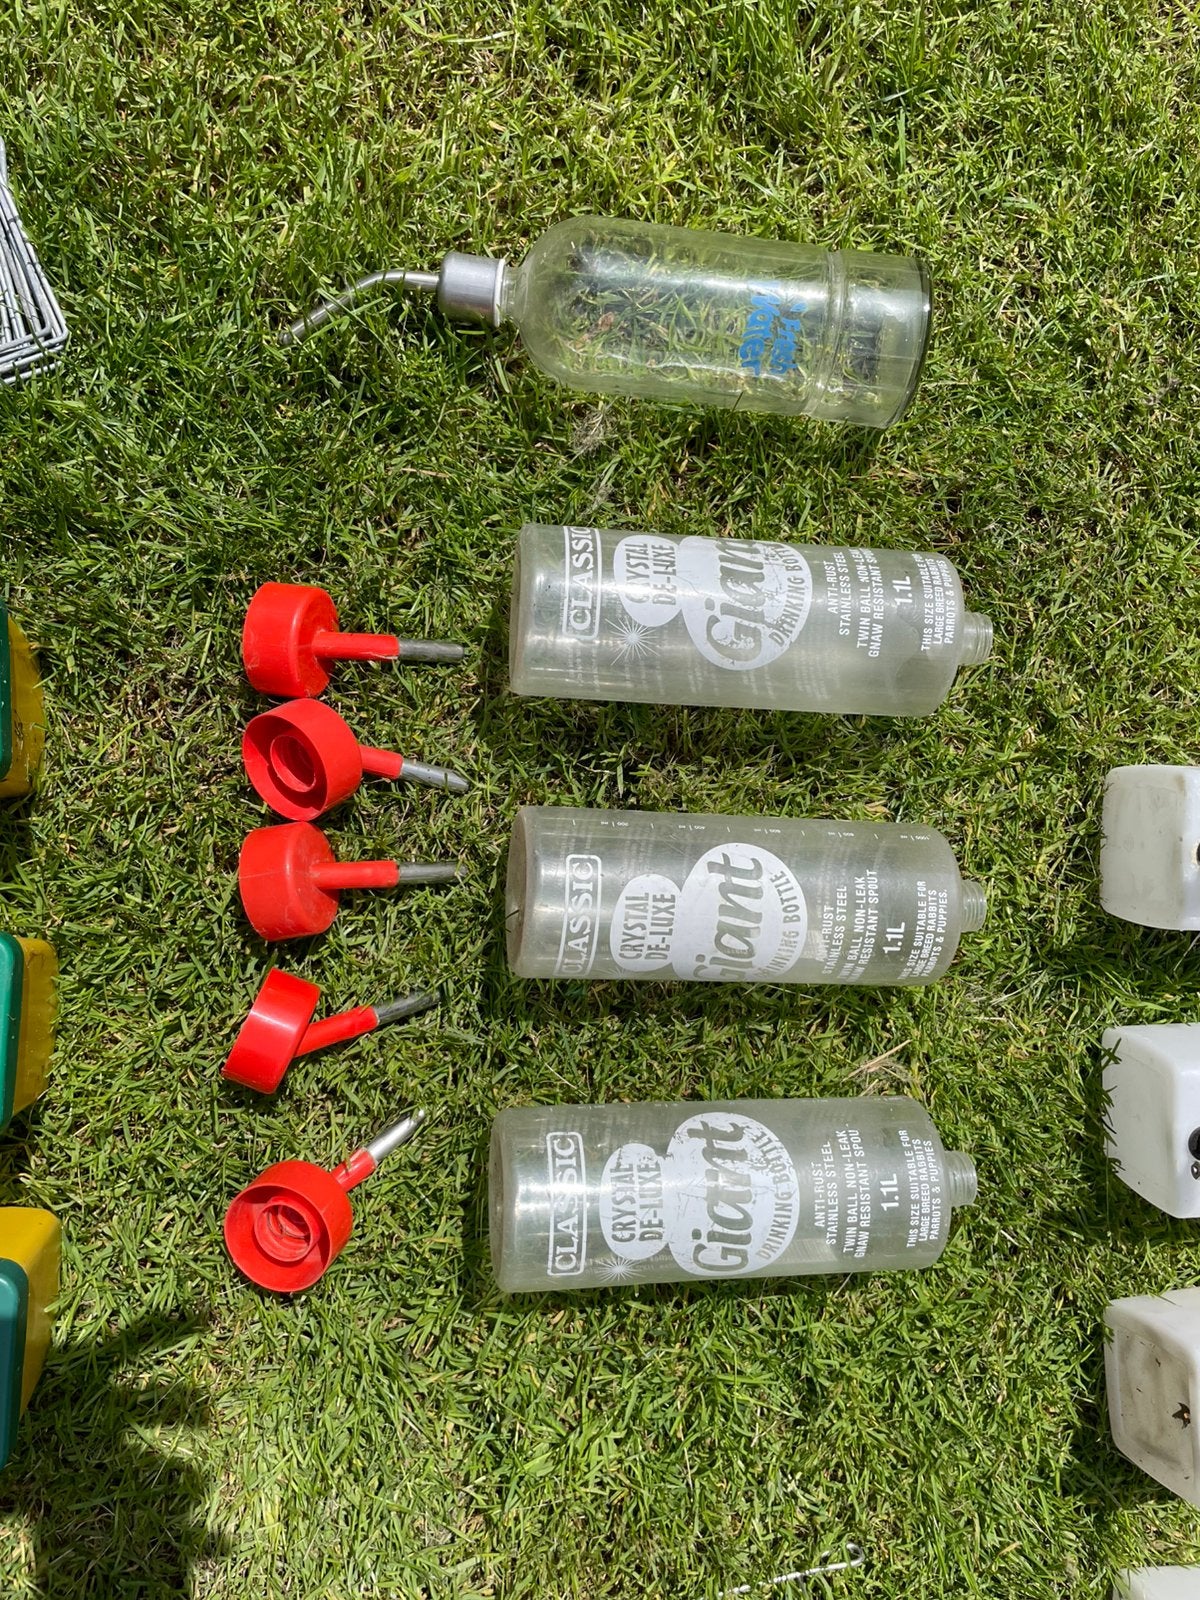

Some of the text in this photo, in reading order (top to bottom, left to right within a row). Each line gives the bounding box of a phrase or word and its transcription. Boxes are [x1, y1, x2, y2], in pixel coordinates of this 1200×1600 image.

[769, 317, 802, 375] Fresh
[625, 543, 650, 604] CYSTAL
[704, 538, 765, 662] Gian
[823, 560, 838, 614] ANTI-RUST
[848, 549, 871, 648] TWIN BALL NON-LEA
[869, 565, 884, 620] RESISTANT
[892, 576, 913, 609] 1.1L
[917, 563, 934, 599] SUITABLE
[934, 587, 945, 613] BREED
[839, 576, 851, 635] STAINLESS
[924, 602, 934, 625] SIZE
[933, 615, 945, 645] LARGE
[944, 600, 956, 644] PARROTS
[868, 624, 884, 657] GNAW
[921, 627, 934, 651] THIS
[770, 870, 801, 924] BOTTLE
[854, 876, 866, 932] NON-LEAK
[866, 869, 878, 904] SPOUT
[917, 880, 926, 898] FOR
[926, 889, 937, 931] RABBITS
[618, 892, 649, 961] CRYSTAL
[644, 894, 676, 961] DE-LUXE
[693, 852, 763, 981] Giant
[822, 886, 847, 975] STAINLESS STEEL
[858, 908, 878, 965] RESISTANT
[882, 922, 905, 954] 1.1L
[913, 900, 926, 947] SUITABLE
[847, 937, 862, 961] BALL
[906, 949, 920, 967] SIZE
[920, 933, 934, 959] BREED
[899, 1129, 920, 1248] THIS SIZE SUITABLE FOR
[923, 1140, 939, 1182] PUPPIES
[554, 1137, 580, 1271] CLASSIC
[610, 1162, 636, 1243] CRYSTAL
[637, 1162, 664, 1242] DE-LUXE
[687, 1120, 753, 1272] Giant
[750, 1130, 793, 1260] DRINKING BOTTLE
[811, 1162, 826, 1228] ANTI-RUST
[822, 1141, 838, 1245] STAINLESS STEEL
[836, 1129, 858, 1253] TWIN BALL NON-LEAK
[850, 1128, 871, 1258] GNAW RESISTANT SPOU
[880, 1173, 899, 1212] 1.1L
[911, 1138, 931, 1241] LARGE BREED RABBITS
[932, 1186, 941, 1194] &
